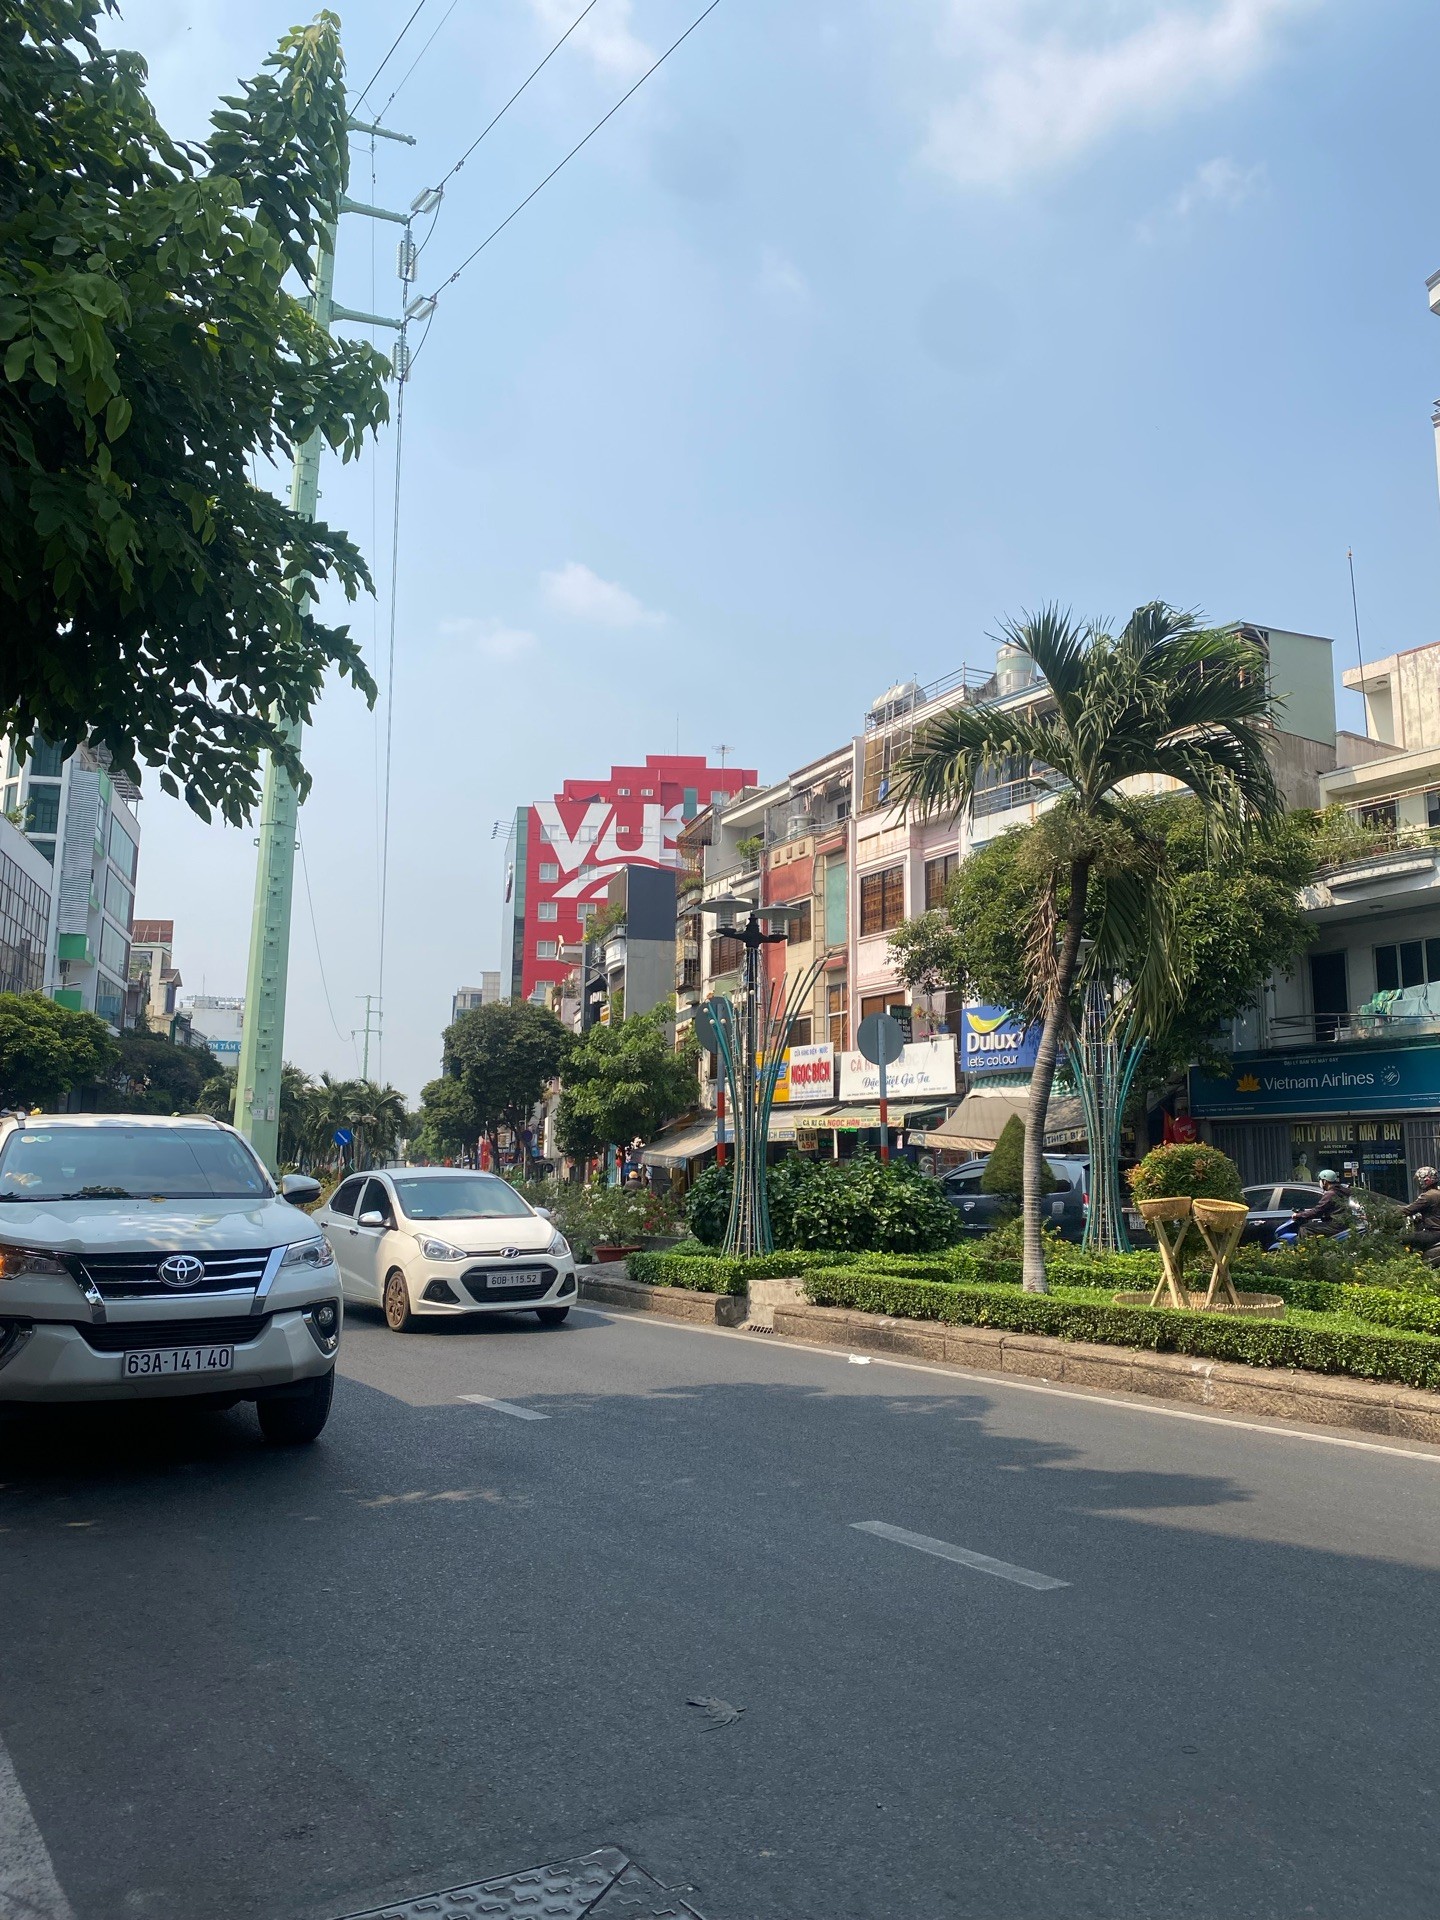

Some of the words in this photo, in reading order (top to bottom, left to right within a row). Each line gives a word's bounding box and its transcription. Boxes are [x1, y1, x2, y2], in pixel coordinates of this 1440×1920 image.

[966, 1031, 1019, 1053] Dulux
[967, 1055, 985, 1067] let's
[986, 1054, 1019, 1067] colour
[791, 1063, 812, 1089] NGỌC
[812, 1057, 831, 1083] BÍCH
[900, 1072, 915, 1087] Gà
[1263, 1077, 1319, 1091] Vietnam
[1321, 1072, 1375, 1088] Airlines
[1383, 1123, 1401, 1141] BAY
[491, 1274, 537, 1285] 60B-115.52
[127, 1348, 230, 1374] 63A-141.40
